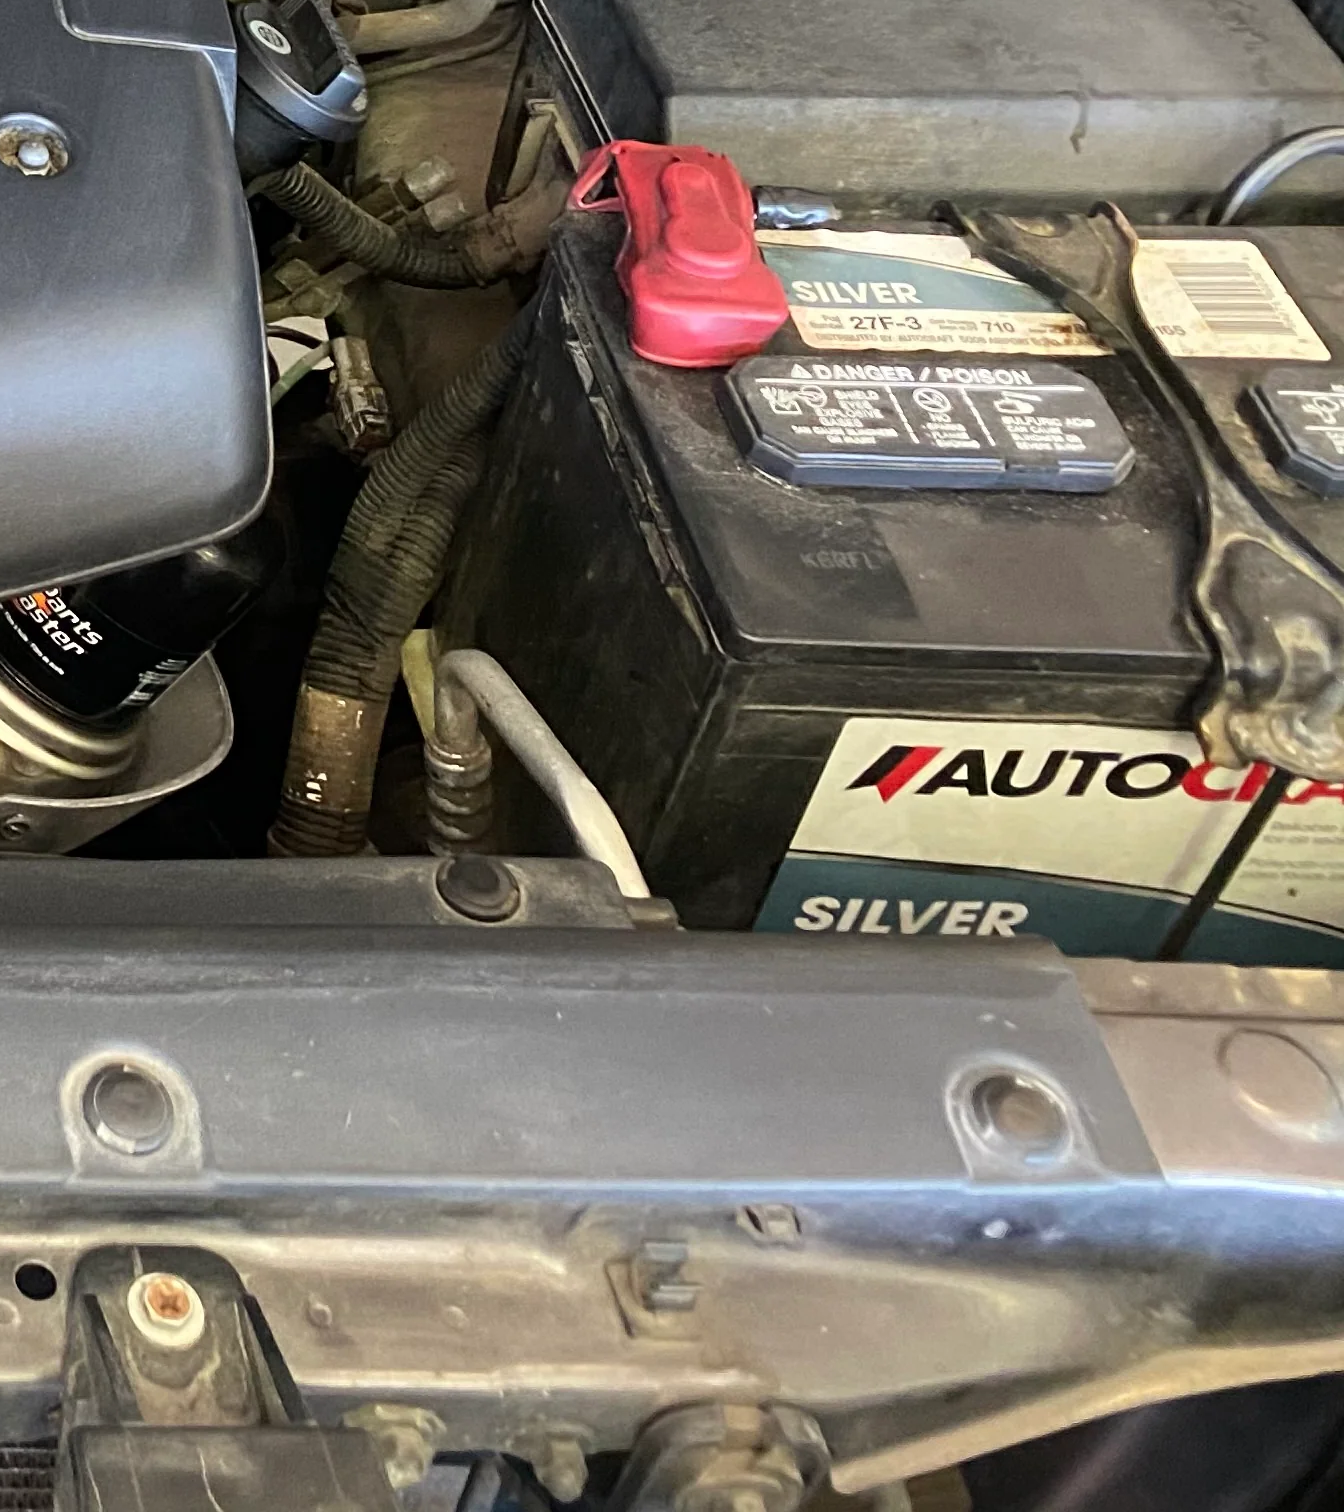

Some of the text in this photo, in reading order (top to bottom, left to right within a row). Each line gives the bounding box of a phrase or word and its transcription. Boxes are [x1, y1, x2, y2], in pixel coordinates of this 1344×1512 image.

[791, 280, 924, 305] SILVER
[849, 315, 923, 330] 27F-3
[980, 320, 1015, 333] 710
[812, 364, 915, 382] DANGER
[936, 367, 1033, 385] POISON
[929, 412, 952, 423] NO
[18, 594, 85, 655] aster
[793, 895, 1029, 938] SILVER
